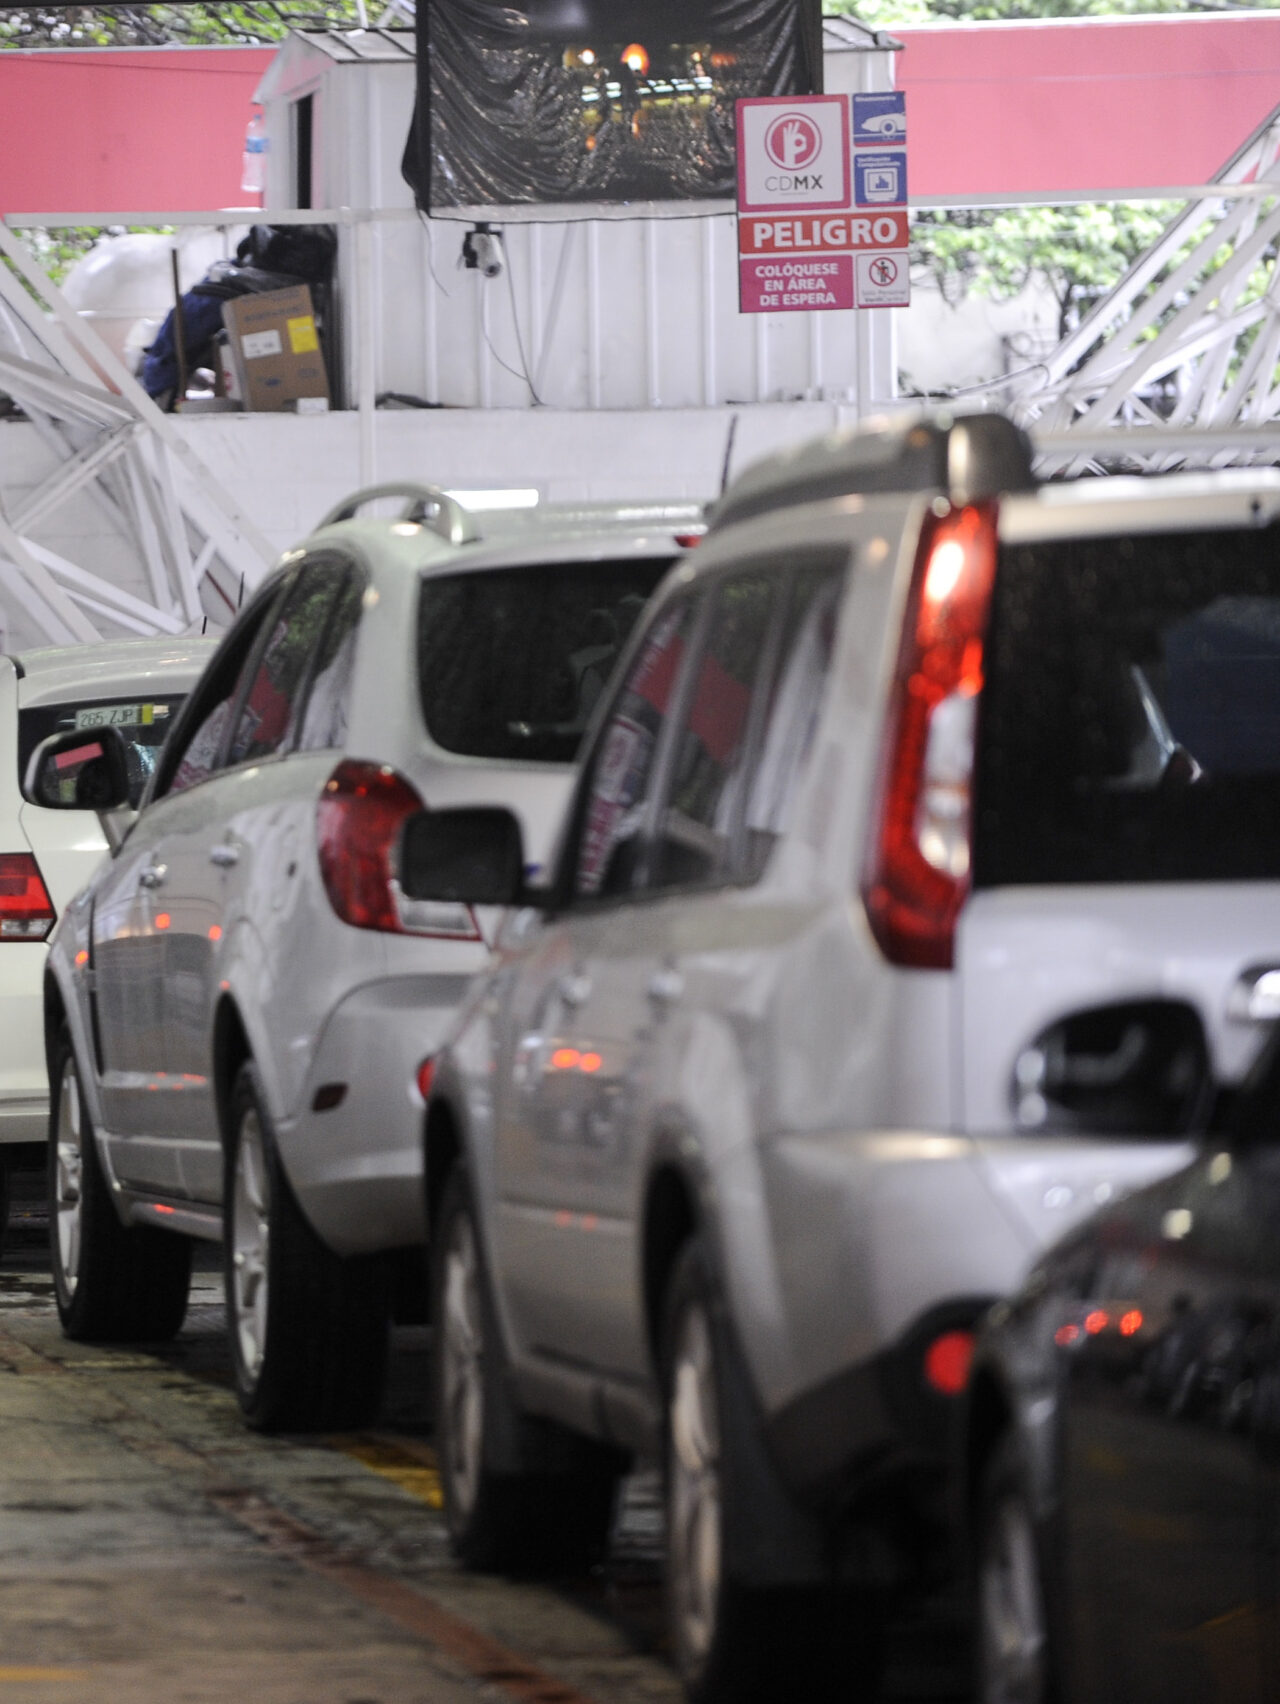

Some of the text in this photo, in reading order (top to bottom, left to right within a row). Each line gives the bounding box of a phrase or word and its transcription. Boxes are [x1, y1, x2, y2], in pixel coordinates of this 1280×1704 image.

[764, 175, 823, 192] CDMX
[753, 217, 898, 248] PELIGRO
[755, 262, 839, 277] COLÓQUESE
[764, 277, 826, 291] EN ÁREA
[760, 292, 836, 306] DE ESPERA
